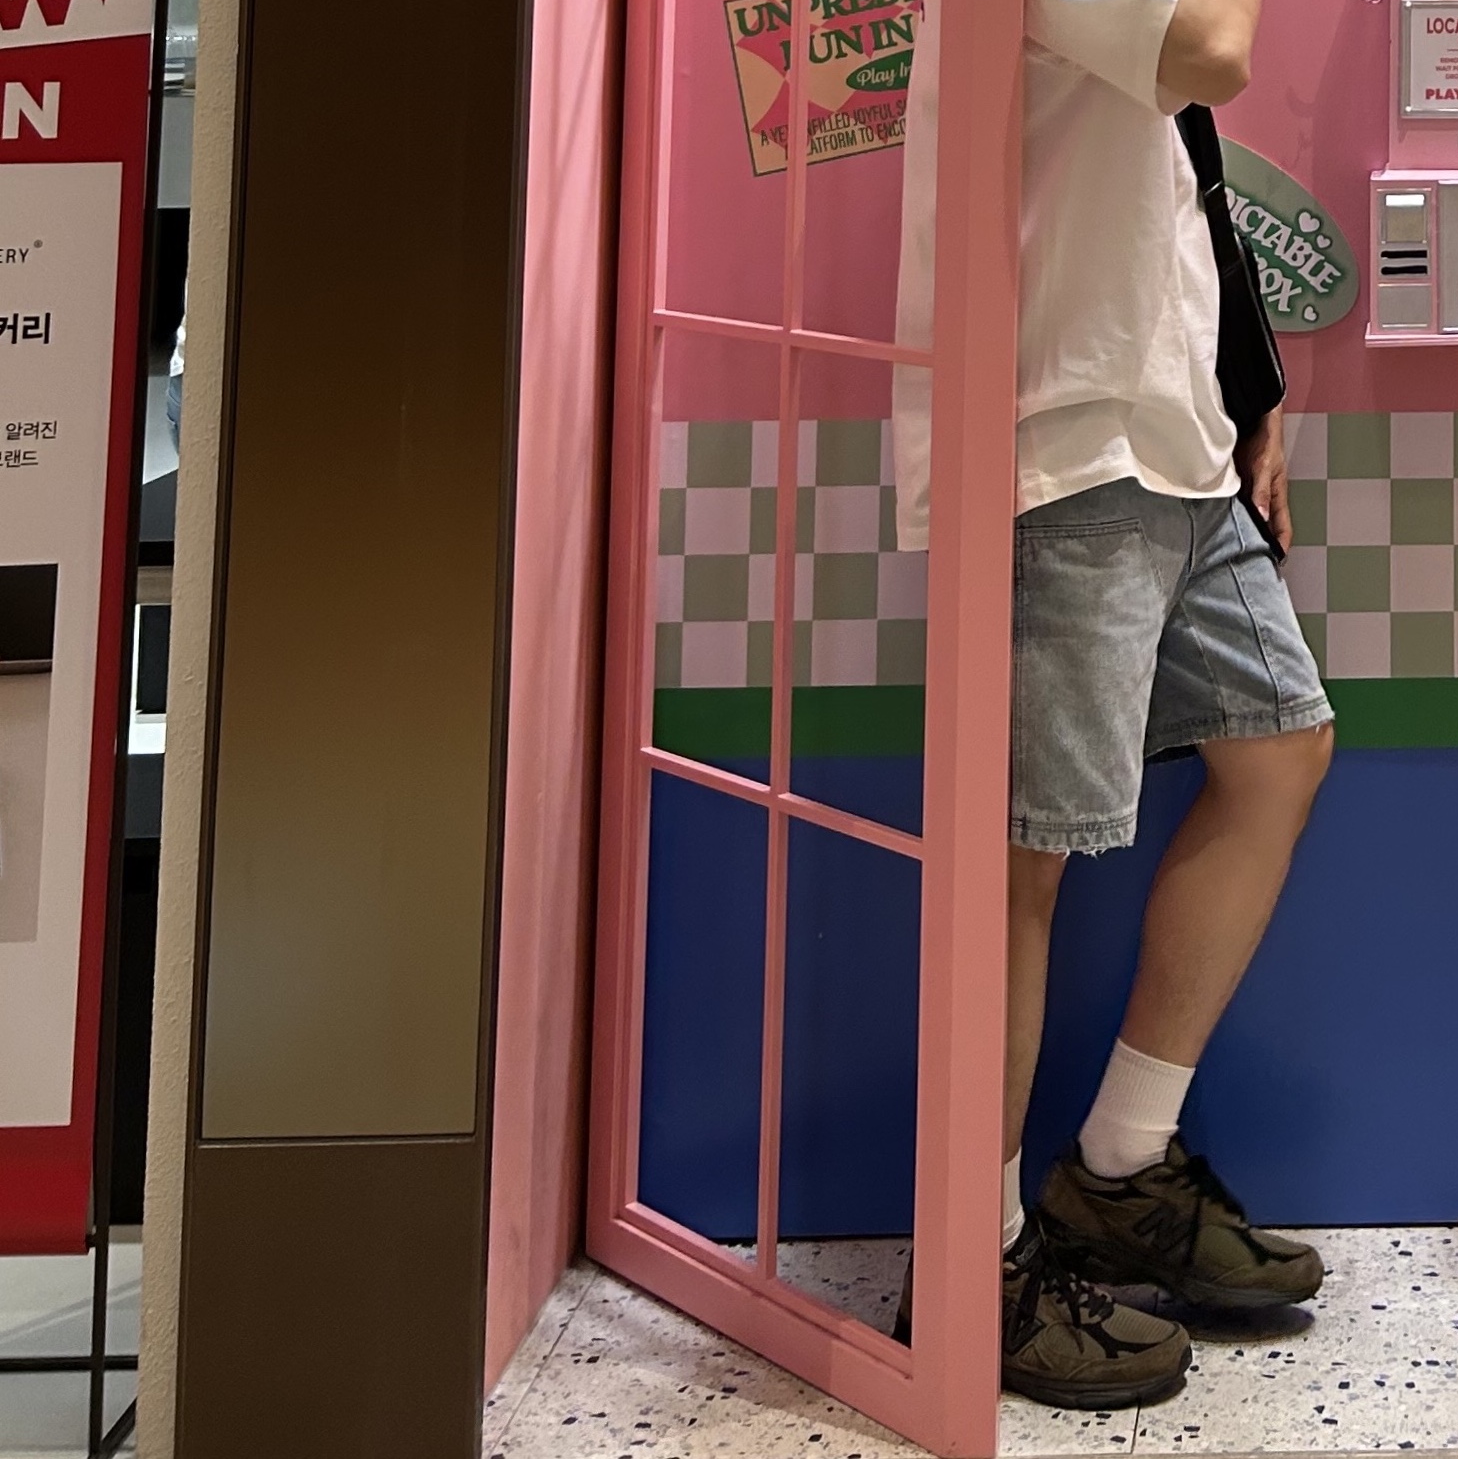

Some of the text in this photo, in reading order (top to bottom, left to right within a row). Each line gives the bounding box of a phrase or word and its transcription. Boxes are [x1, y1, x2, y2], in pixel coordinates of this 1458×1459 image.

[868, 13, 914, 51] IN
[856, 66, 896, 87] Play
[760, 128, 769, 147] A
[852, 104, 894, 126] JOYFUL
[859, 126, 875, 144] TO
[5, 420, 58, 441] 알려진
